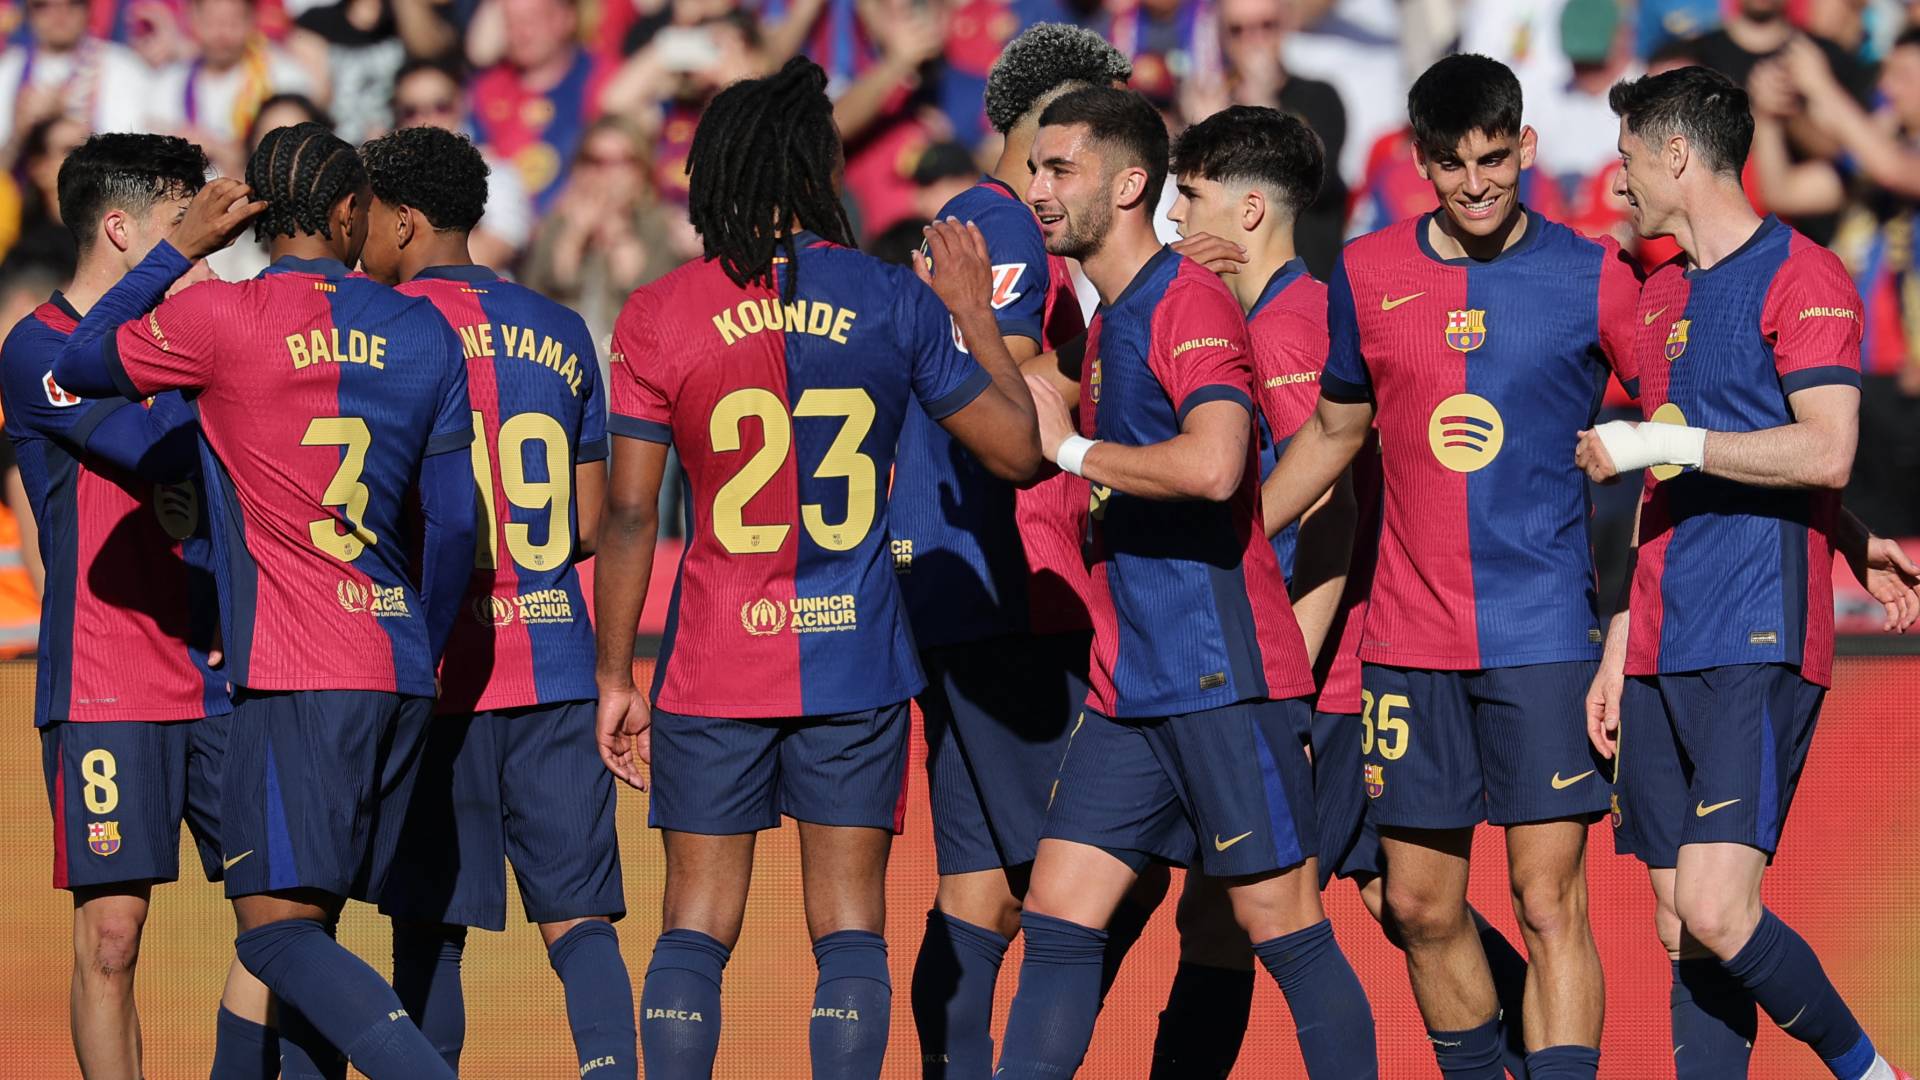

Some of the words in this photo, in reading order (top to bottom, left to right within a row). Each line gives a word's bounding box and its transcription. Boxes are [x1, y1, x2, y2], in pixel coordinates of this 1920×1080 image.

[712, 298, 857, 346] KOUNDE
[1799, 306, 1854, 321] AMBILIGHT
[286, 328, 387, 370] BALDE
[459, 323, 496, 360] NE
[501, 323, 584, 398] YAMAL
[1173, 337, 1229, 359] AMBILIGHT
[709, 387, 877, 554] 23
[300, 417, 378, 563] 3
[512, 589, 569, 606] UNHCR
[519, 603, 572, 618] ACNUR
[789, 594, 856, 613] UNHCR
[790, 609, 857, 627] ACNUR
[82, 748, 119, 815] 8
